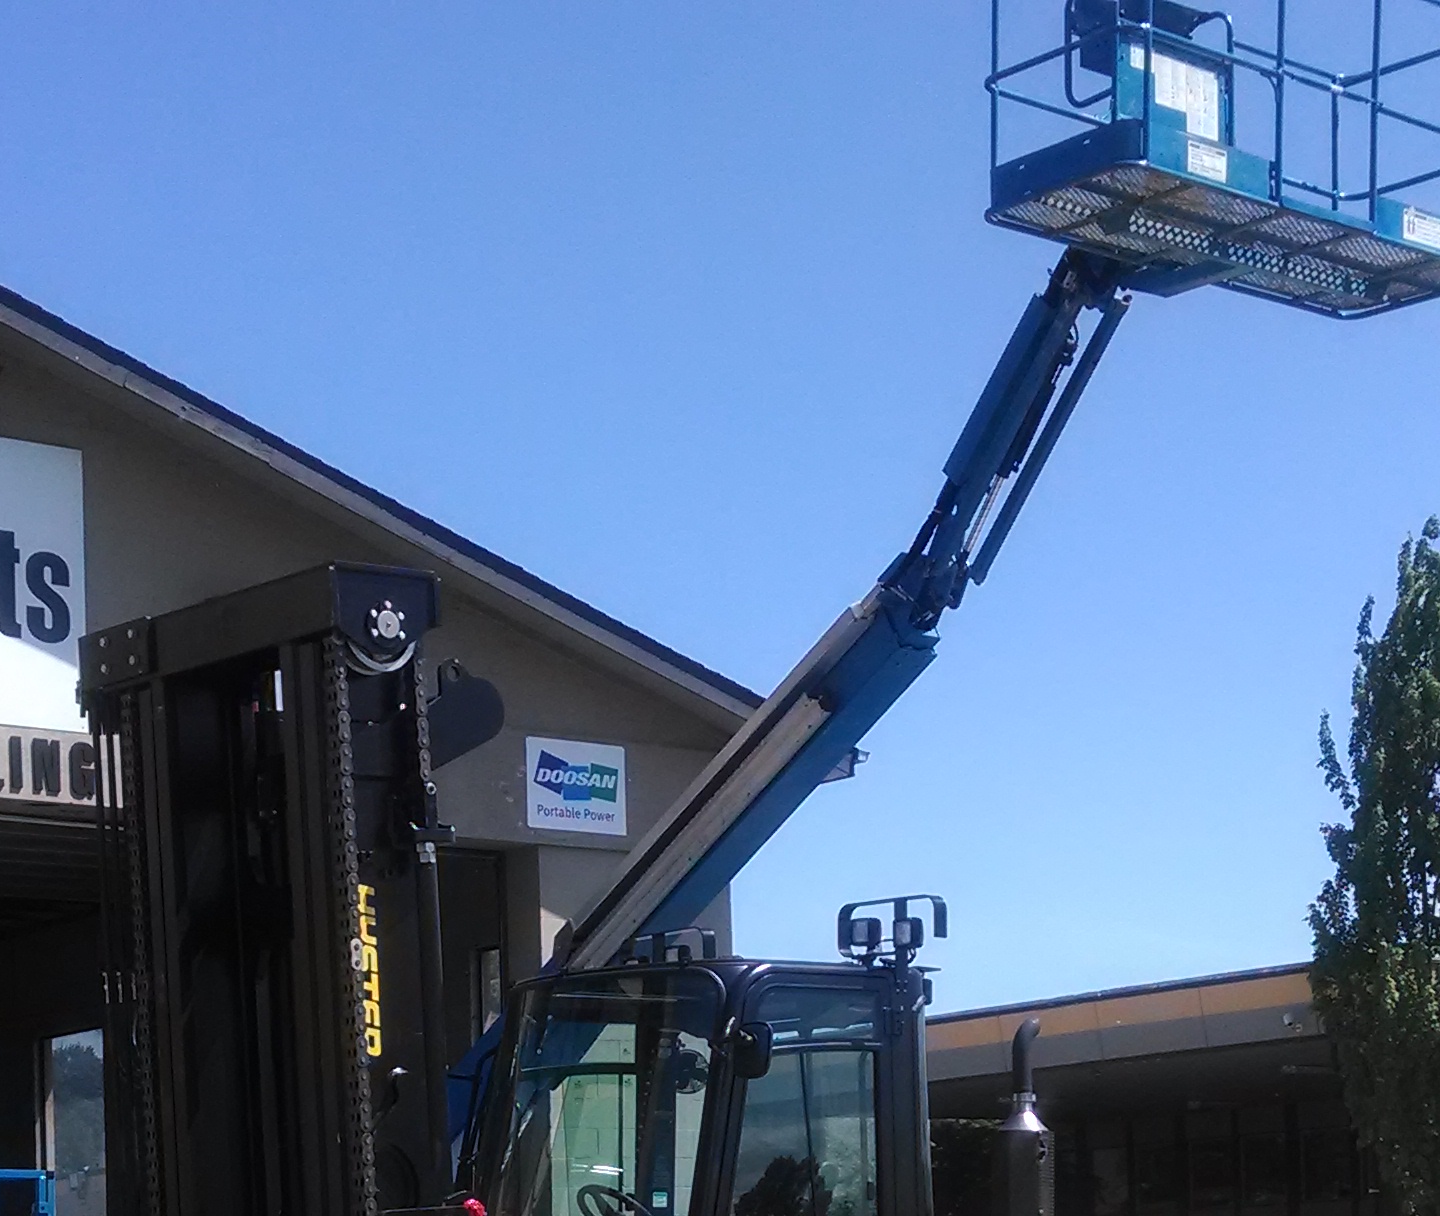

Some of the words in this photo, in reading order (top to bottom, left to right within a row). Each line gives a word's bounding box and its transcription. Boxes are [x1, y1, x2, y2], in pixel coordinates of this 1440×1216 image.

[536, 767, 616, 789] DOOSAN
[537, 804, 581, 819] Portable
[583, 808, 615, 822] Power
